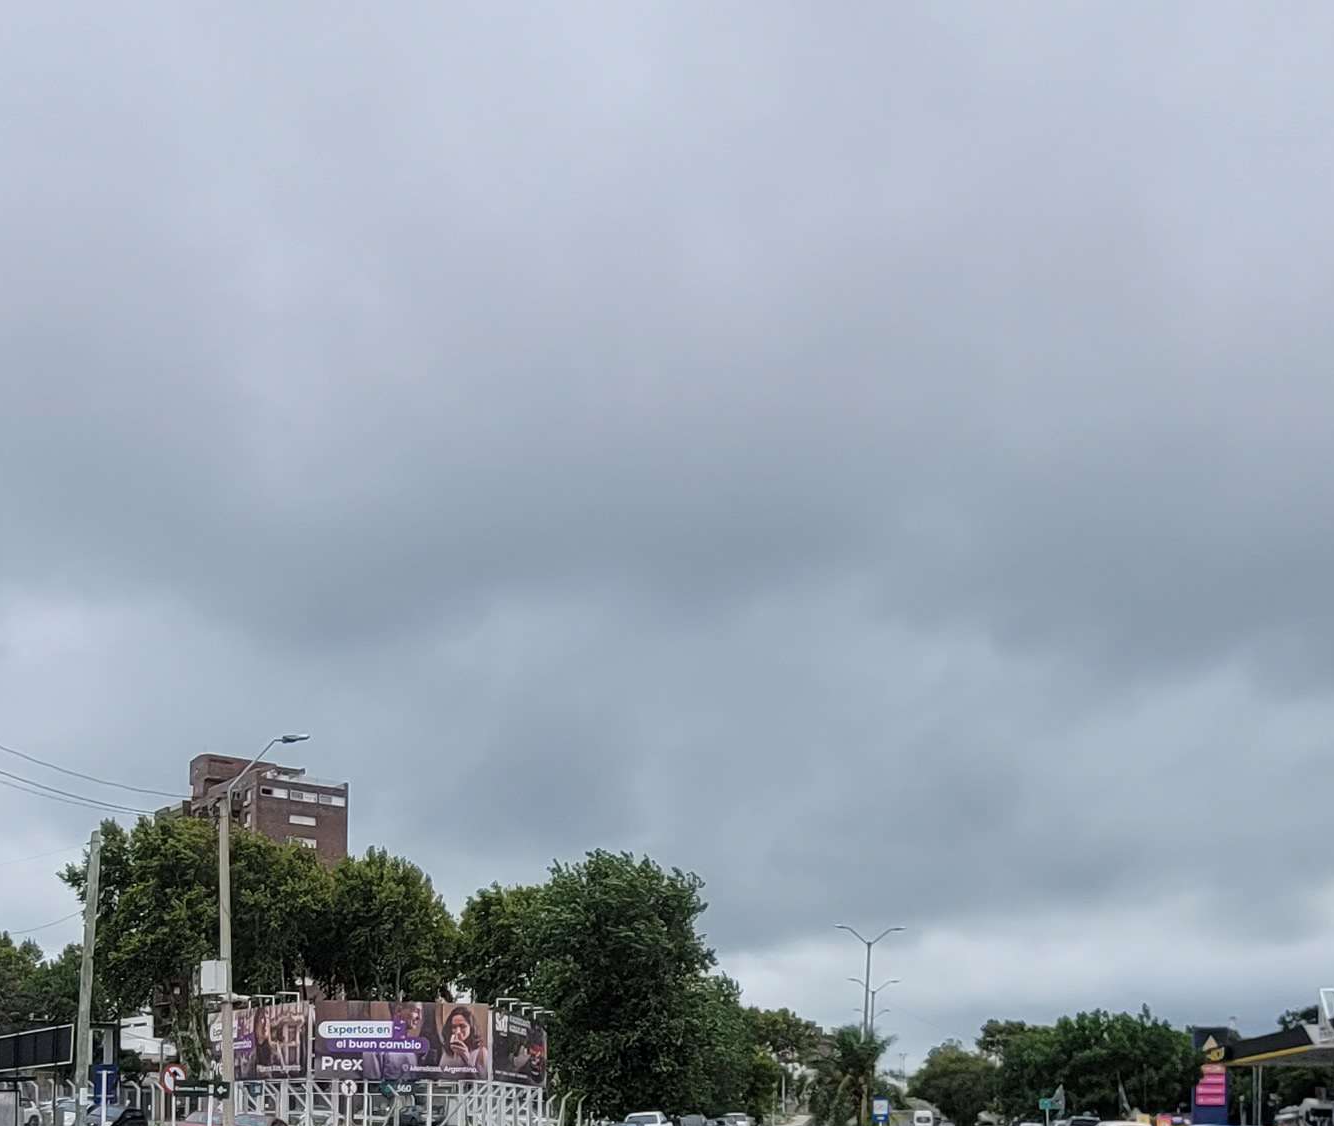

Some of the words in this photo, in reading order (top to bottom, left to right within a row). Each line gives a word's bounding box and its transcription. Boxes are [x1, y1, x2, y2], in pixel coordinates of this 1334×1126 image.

[327, 1025, 374, 1036] Expertos
[336, 1040, 347, 1048] el
[348, 1040, 377, 1049] buen
[379, 1040, 422, 1050] cambio
[321, 1056, 364, 1071] Prex
